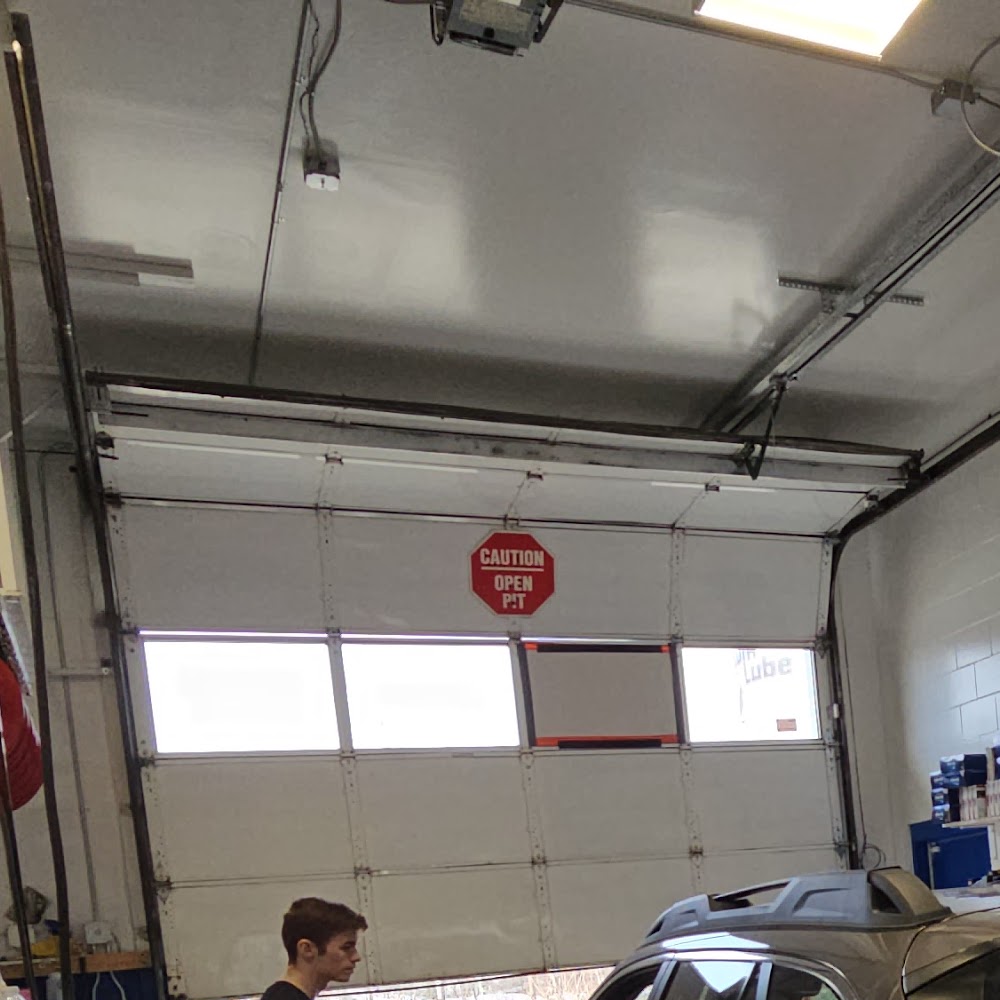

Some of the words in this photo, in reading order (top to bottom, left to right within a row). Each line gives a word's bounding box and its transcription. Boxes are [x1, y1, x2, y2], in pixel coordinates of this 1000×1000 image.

[480, 548, 545, 567] CAUTION
[494, 575, 533, 592] OPEN
[502, 593, 527, 610] PIT
